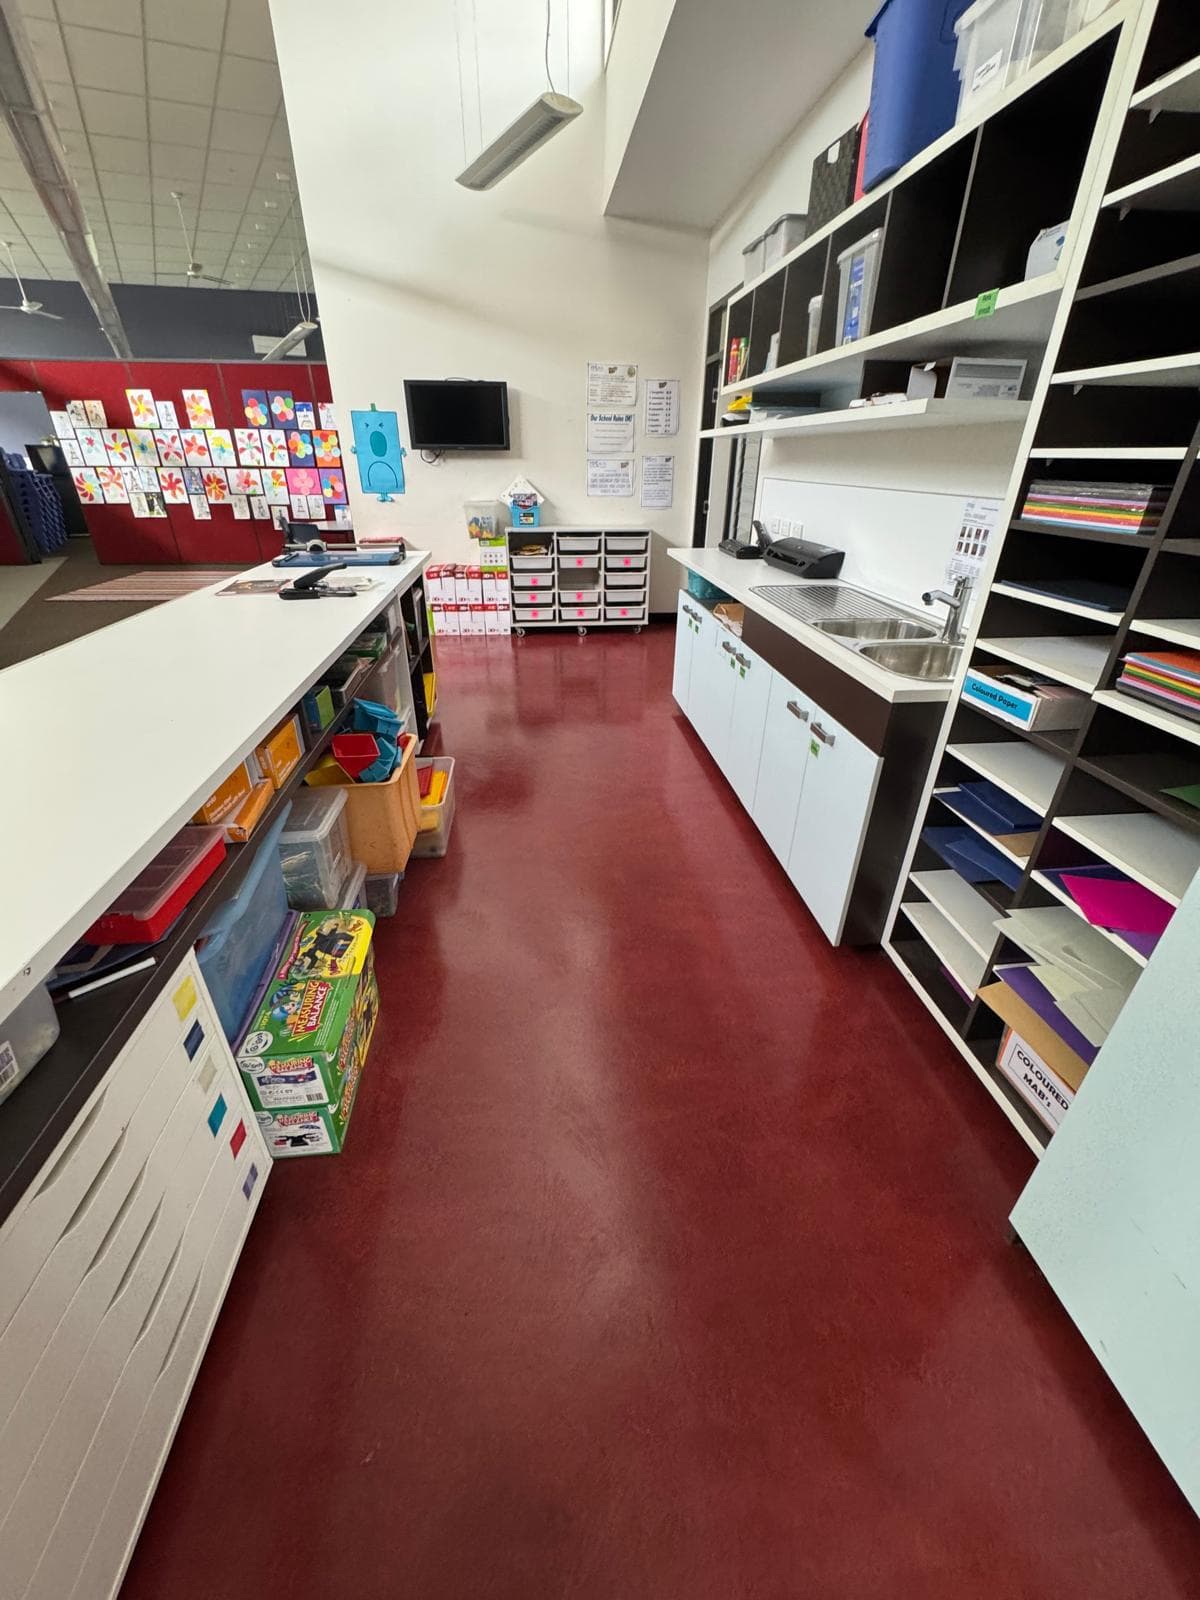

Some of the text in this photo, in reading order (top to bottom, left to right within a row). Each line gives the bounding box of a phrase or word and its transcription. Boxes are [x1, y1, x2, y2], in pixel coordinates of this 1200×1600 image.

[599, 414, 612, 422] School
[971, 683, 1018, 710] Coloured Paper
[297, 981, 320, 1033] MEASURING
[306, 985, 328, 1027] BALANCE
[1017, 1050, 1069, 1111] COLOURED
[1023, 1074, 1051, 1108] MAB's
